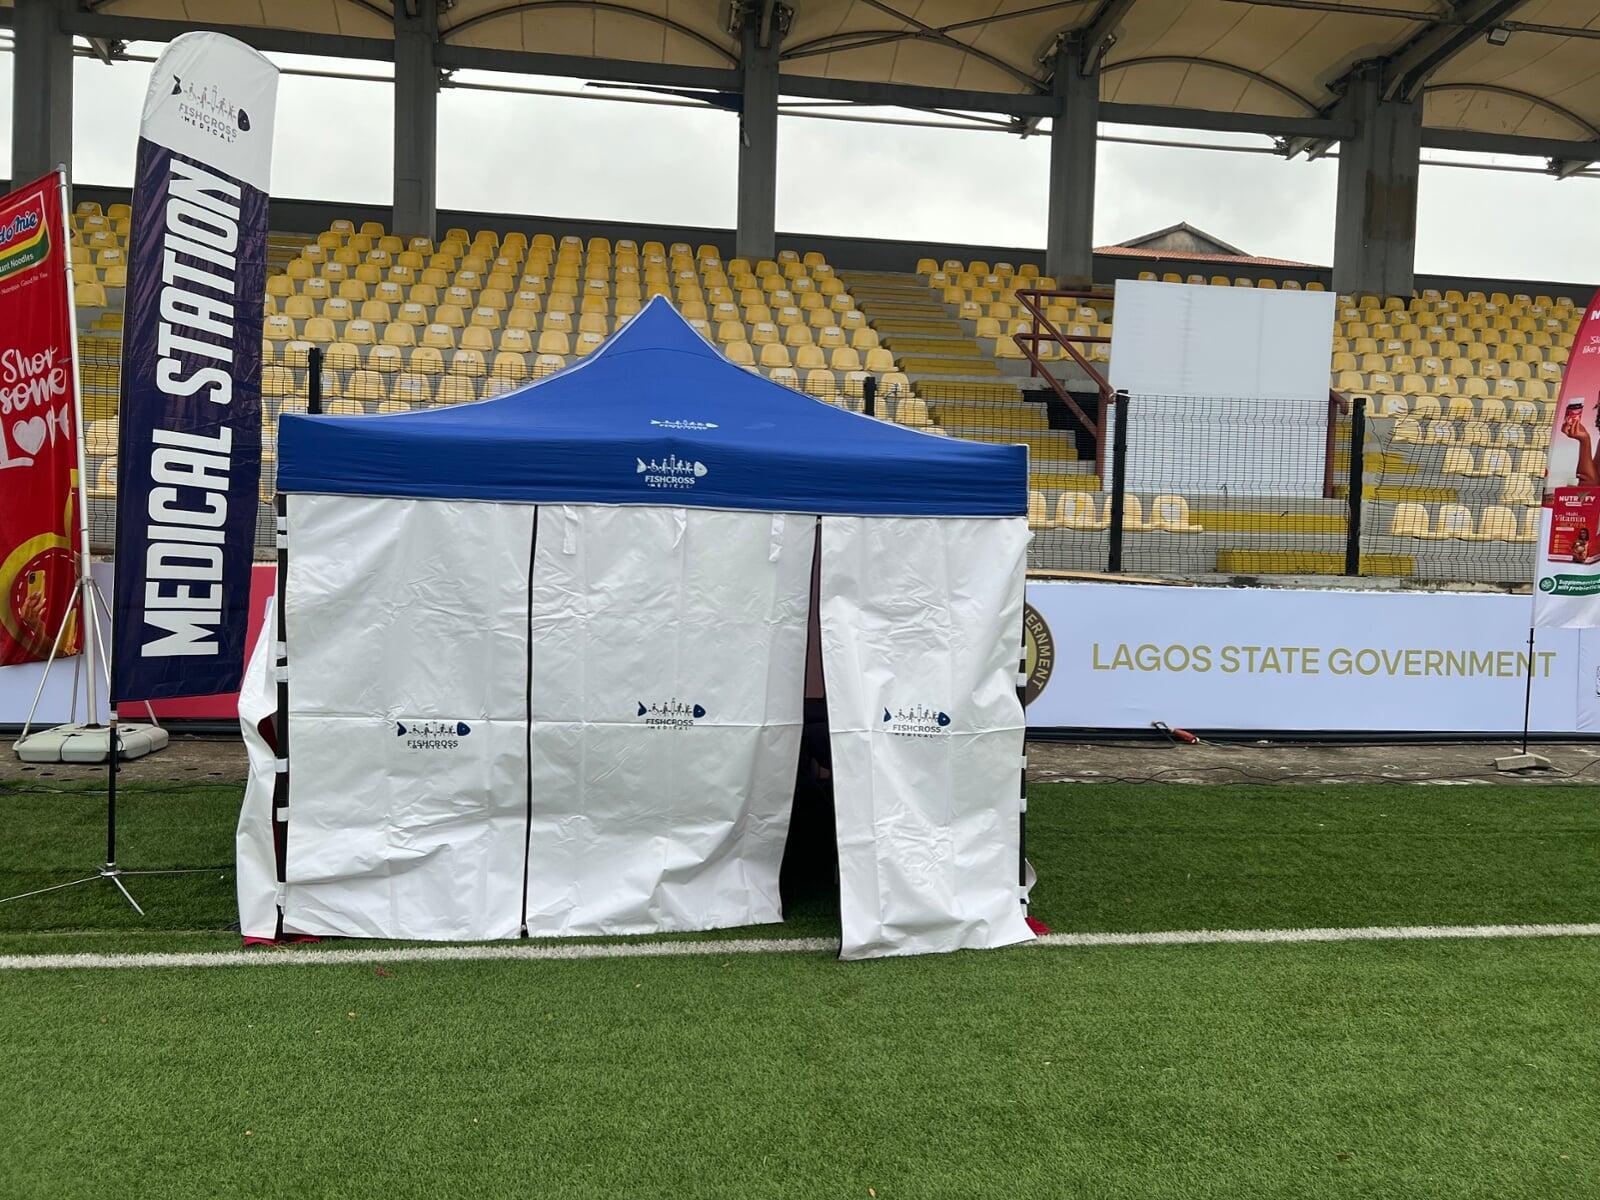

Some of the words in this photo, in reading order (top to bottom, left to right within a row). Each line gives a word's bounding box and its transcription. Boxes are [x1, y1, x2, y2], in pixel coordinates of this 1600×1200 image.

[179, 102, 238, 138] FISHCROSS
[0, 211, 39, 244] domie
[156, 158, 242, 405] STATION
[645, 475, 696, 485] FISHCROSS
[141, 426, 233, 658] MEDICAL
[1025, 609, 1051, 690] ERNMENT
[1092, 643, 1213, 673] LAGOS
[1220, 645, 1321, 675] STATE
[1328, 648, 1557, 677] GOVERNMENT
[646, 718, 694, 726] FISHCROSS
[893, 724, 942, 734] FISHCROSS
[407, 740, 459, 748] FISHCROSS
